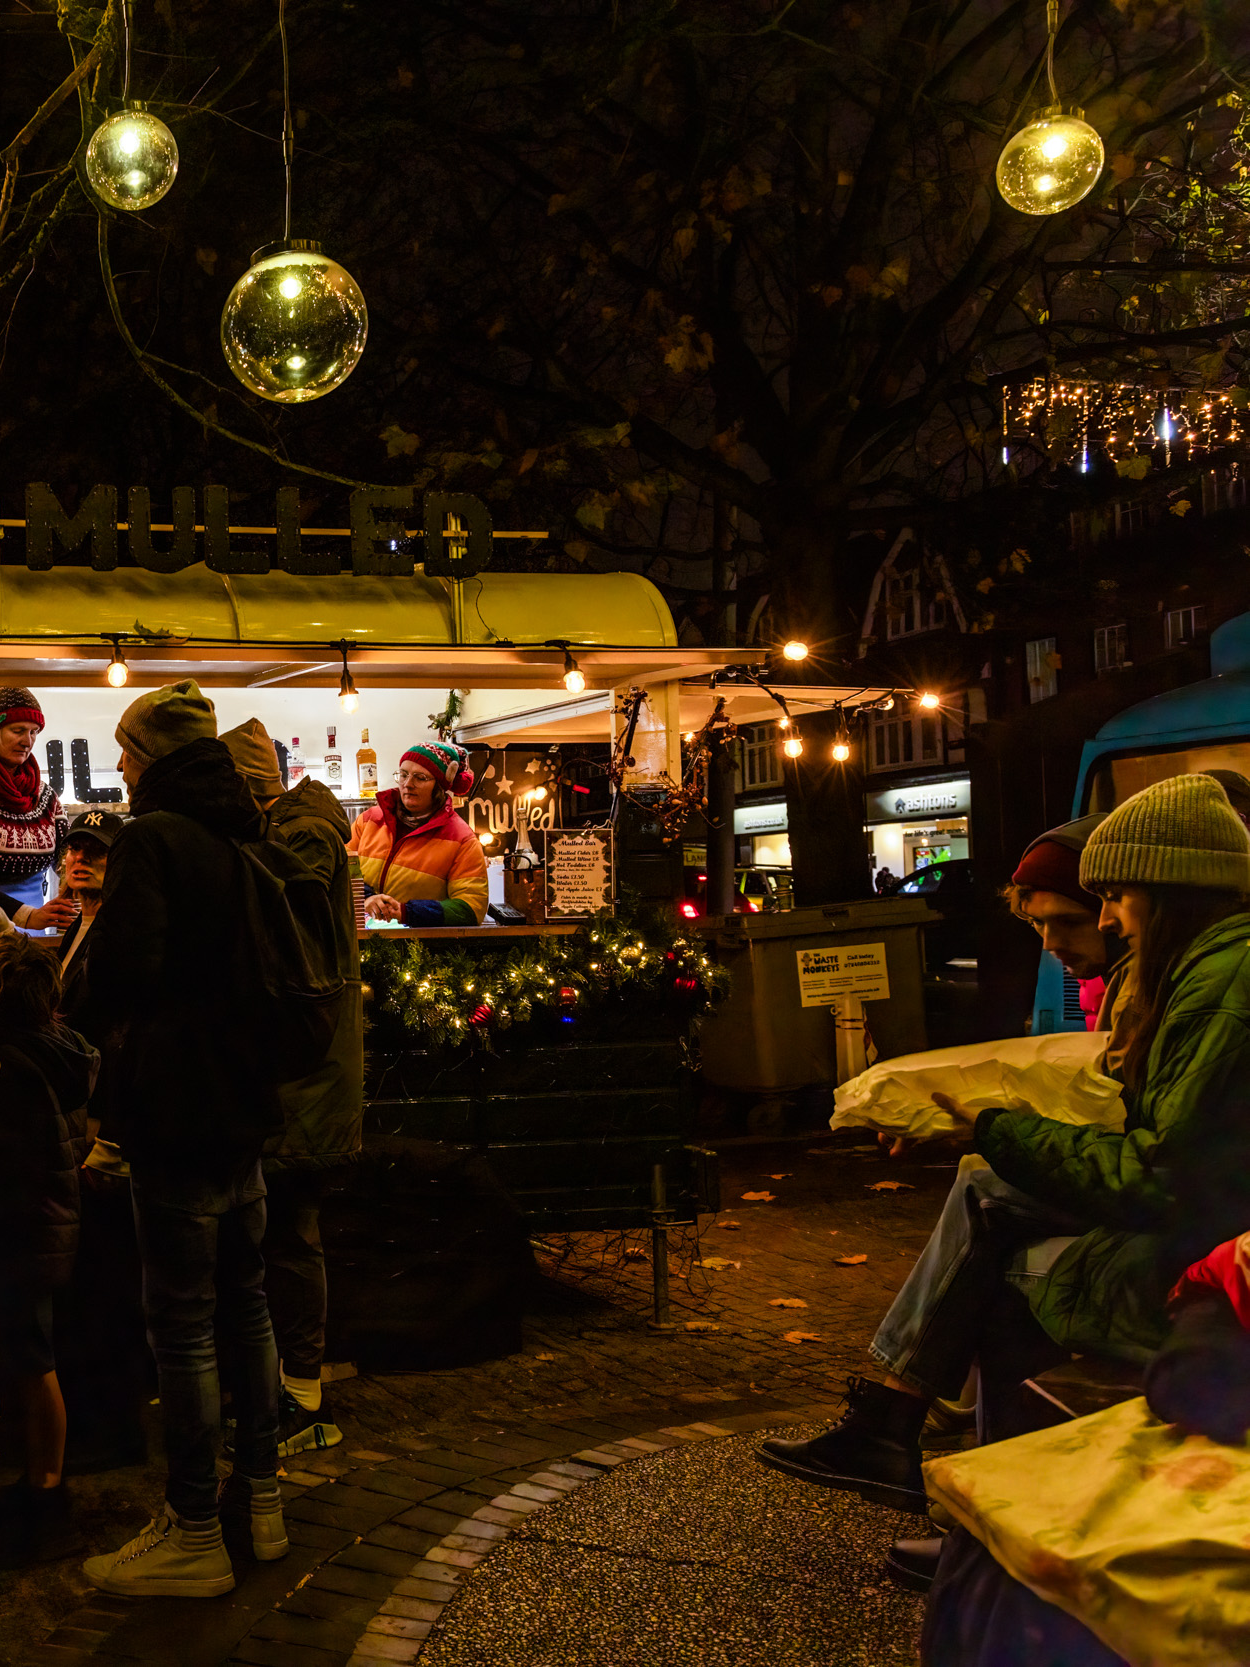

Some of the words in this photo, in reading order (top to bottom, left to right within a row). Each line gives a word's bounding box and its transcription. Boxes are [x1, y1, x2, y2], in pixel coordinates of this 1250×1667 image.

[25, 481, 493, 578] MULLED
[906, 794, 957, 812] ashtons
[84, 812, 103, 826] NY
[813, 955, 839, 964] WASTE
[803, 963, 840, 975] MONKEYS
